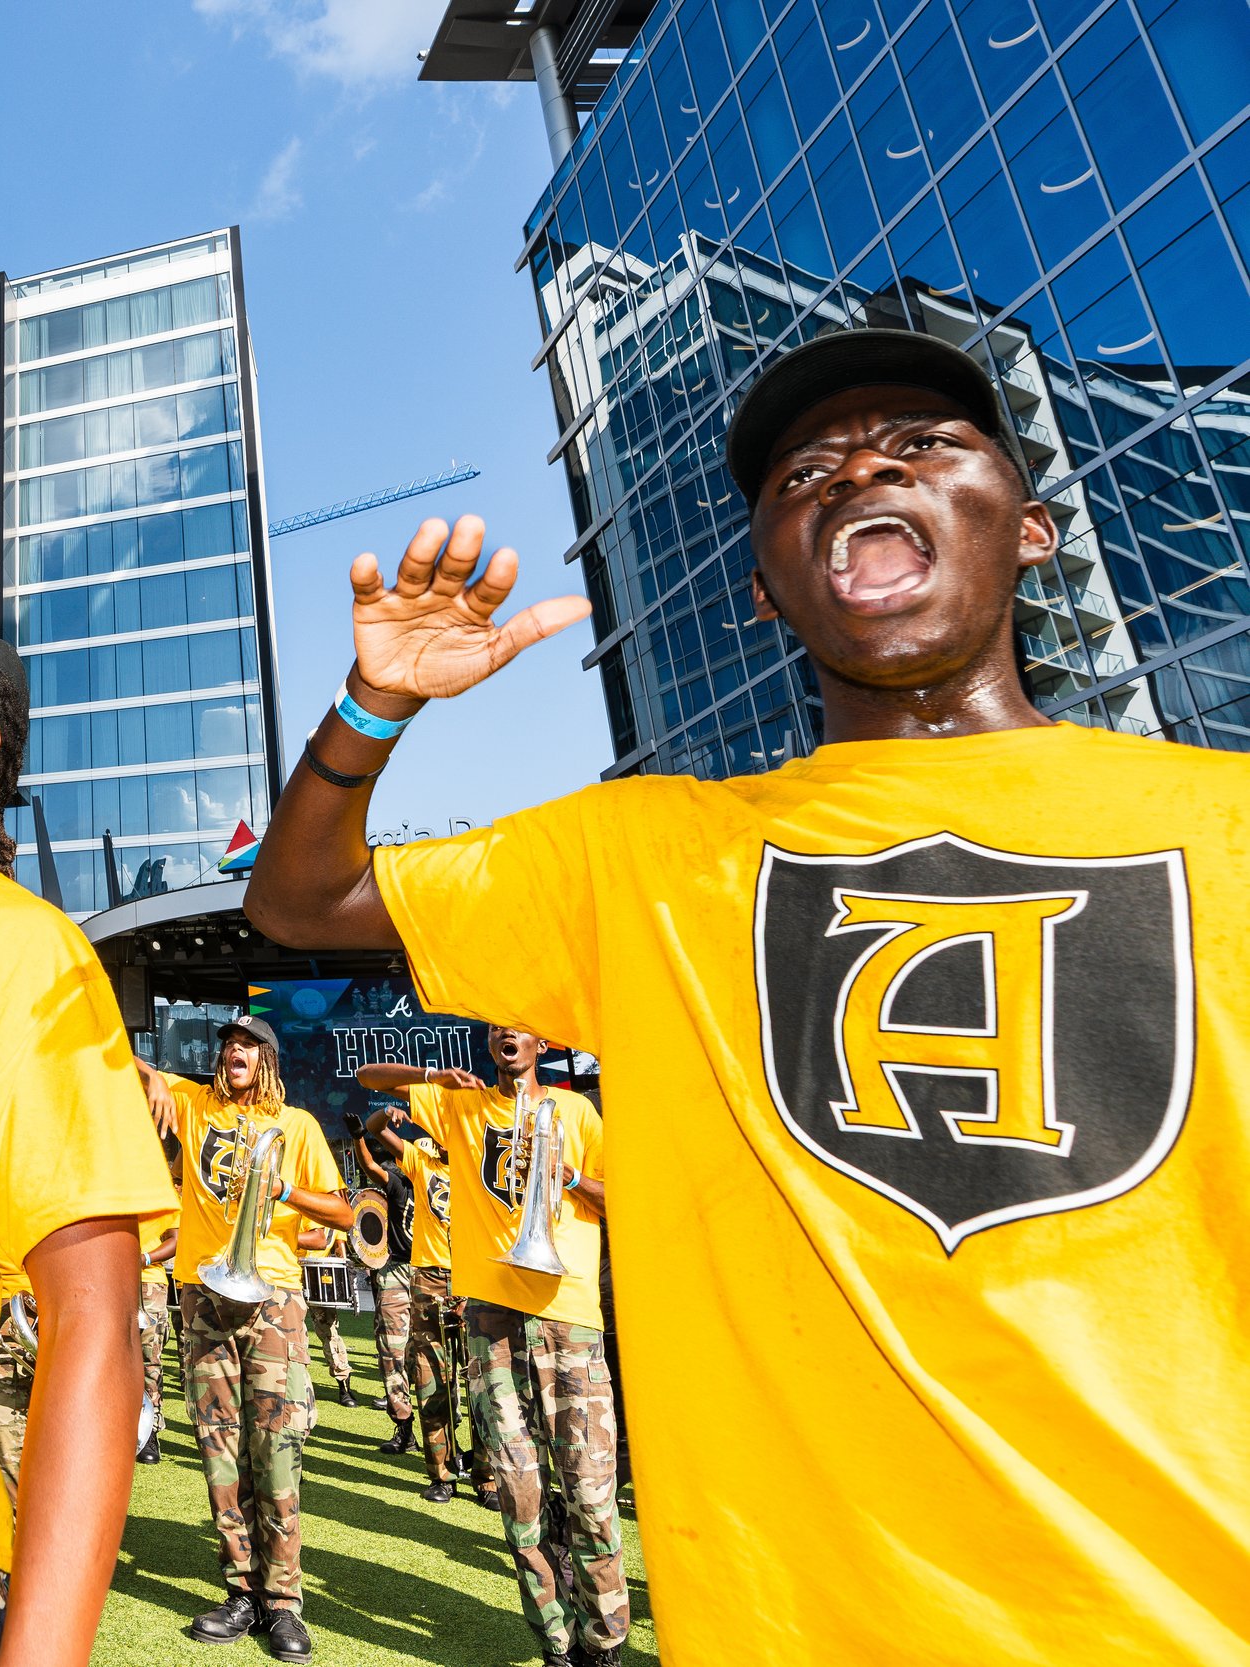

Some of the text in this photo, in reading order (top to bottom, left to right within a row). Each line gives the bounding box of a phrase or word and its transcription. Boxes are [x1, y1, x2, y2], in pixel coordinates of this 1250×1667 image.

[385, 994, 413, 1018] A
[824, 887, 1089, 1157] A
[333, 1026, 473, 1077] HBCU
